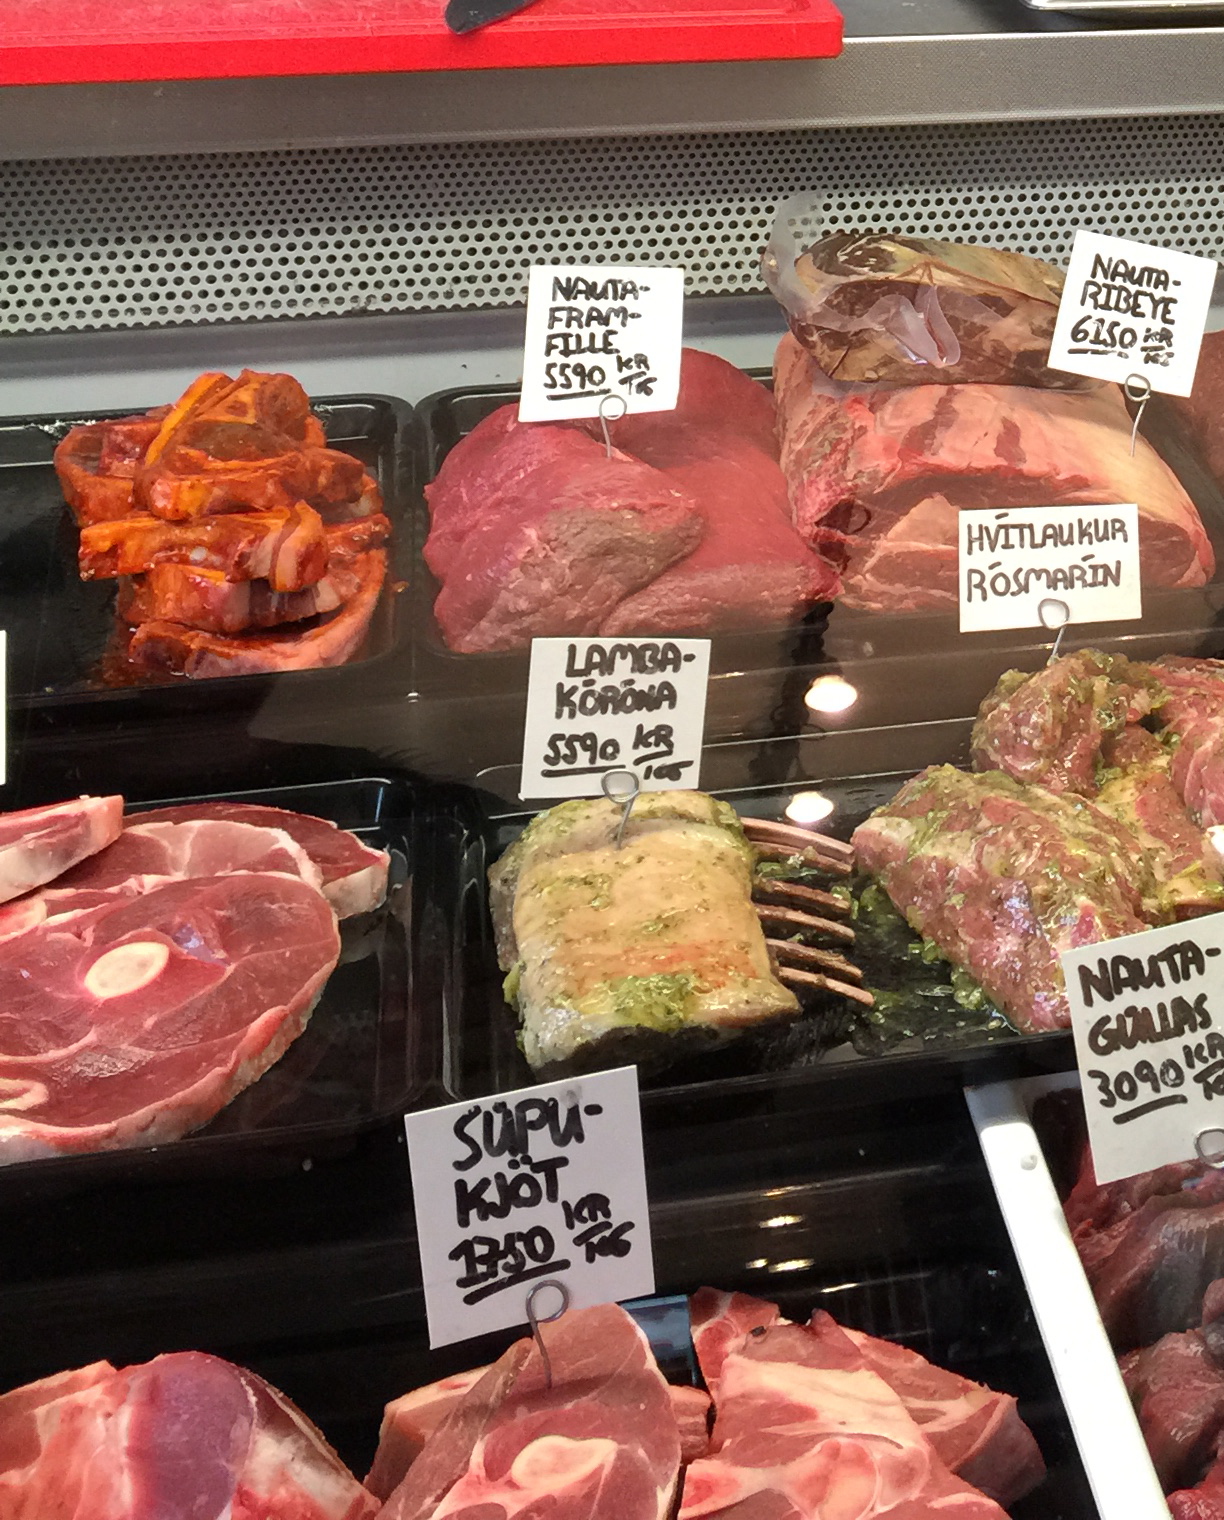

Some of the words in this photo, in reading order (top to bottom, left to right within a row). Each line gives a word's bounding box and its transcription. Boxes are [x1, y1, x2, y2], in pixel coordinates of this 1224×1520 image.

[552, 276, 651, 301] NAUTA-
[1090, 253, 1182, 292] NAUTA-
[548, 306, 642, 330] FRAM-
[1080, 280, 1178, 325] RIBEYE
[544, 329, 620, 358] FILLE
[1070, 315, 1138, 349] 6150
[543, 362, 606, 390] 5590
[616, 353, 650, 373] KR
[966, 512, 1128, 556] HVÍTLAUKUR
[967, 553, 1121, 603] RÓSMARÍN
[565, 642, 696, 678] LAMBA-
[543, 732, 620, 766] 5590
[632, 724, 674, 750] KR
[1078, 939, 1222, 1007] NAUTA-
[1087, 1058, 1186, 1108] 3090
[454, 1154, 569, 1228] KJÖT
[561, 1193, 612, 1230] KR
